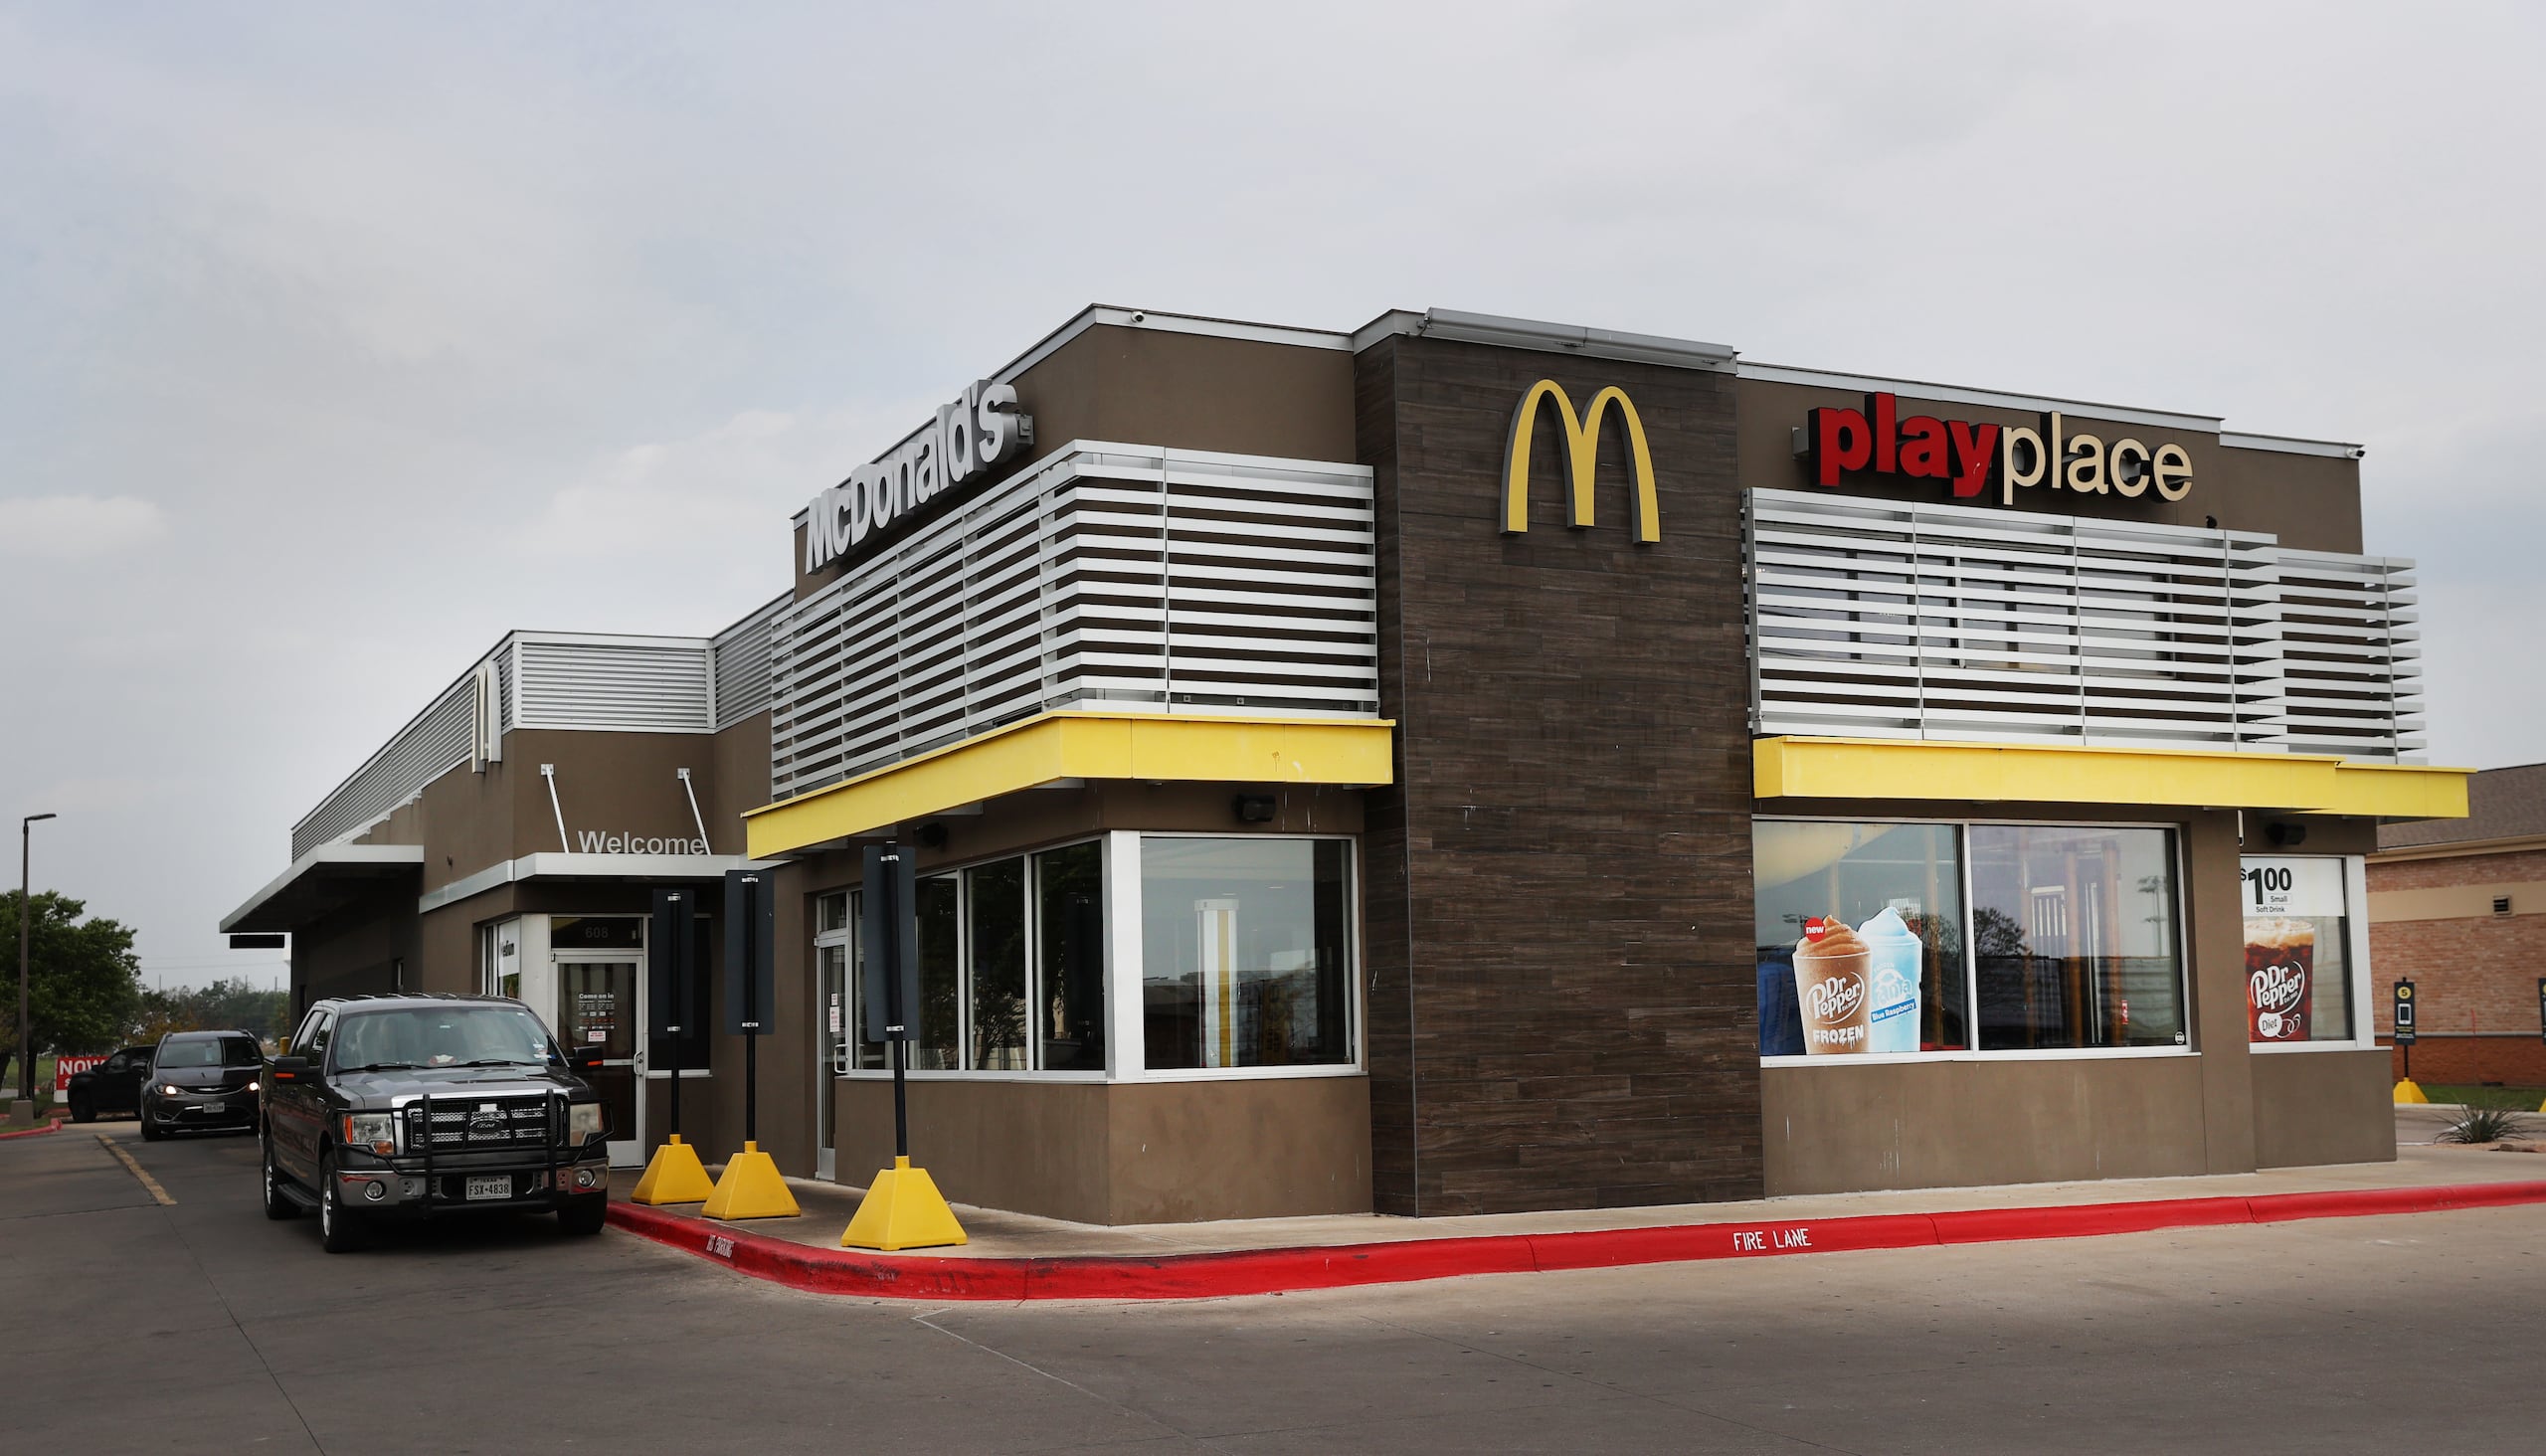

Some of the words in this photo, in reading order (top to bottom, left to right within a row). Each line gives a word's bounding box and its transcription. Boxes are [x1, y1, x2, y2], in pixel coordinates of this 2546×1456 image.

[806, 379, 1018, 575] McDonald's
[577, 830, 705, 854] Welcome
[585, 927, 609, 938] 608
[1805, 925, 1825, 934] new
[1824, 977, 1847, 999] Dr
[2267, 965, 2288, 989] Dr
[2251, 970, 2301, 1010] Pepper
[1872, 1010, 1885, 1020] Blue
[2262, 1018, 2277, 1031] Diet
[1812, 1023, 1865, 1048] FROZEN
[1732, 1231, 1767, 1251] FIRE
[1772, 1228, 1813, 1248] LANE
